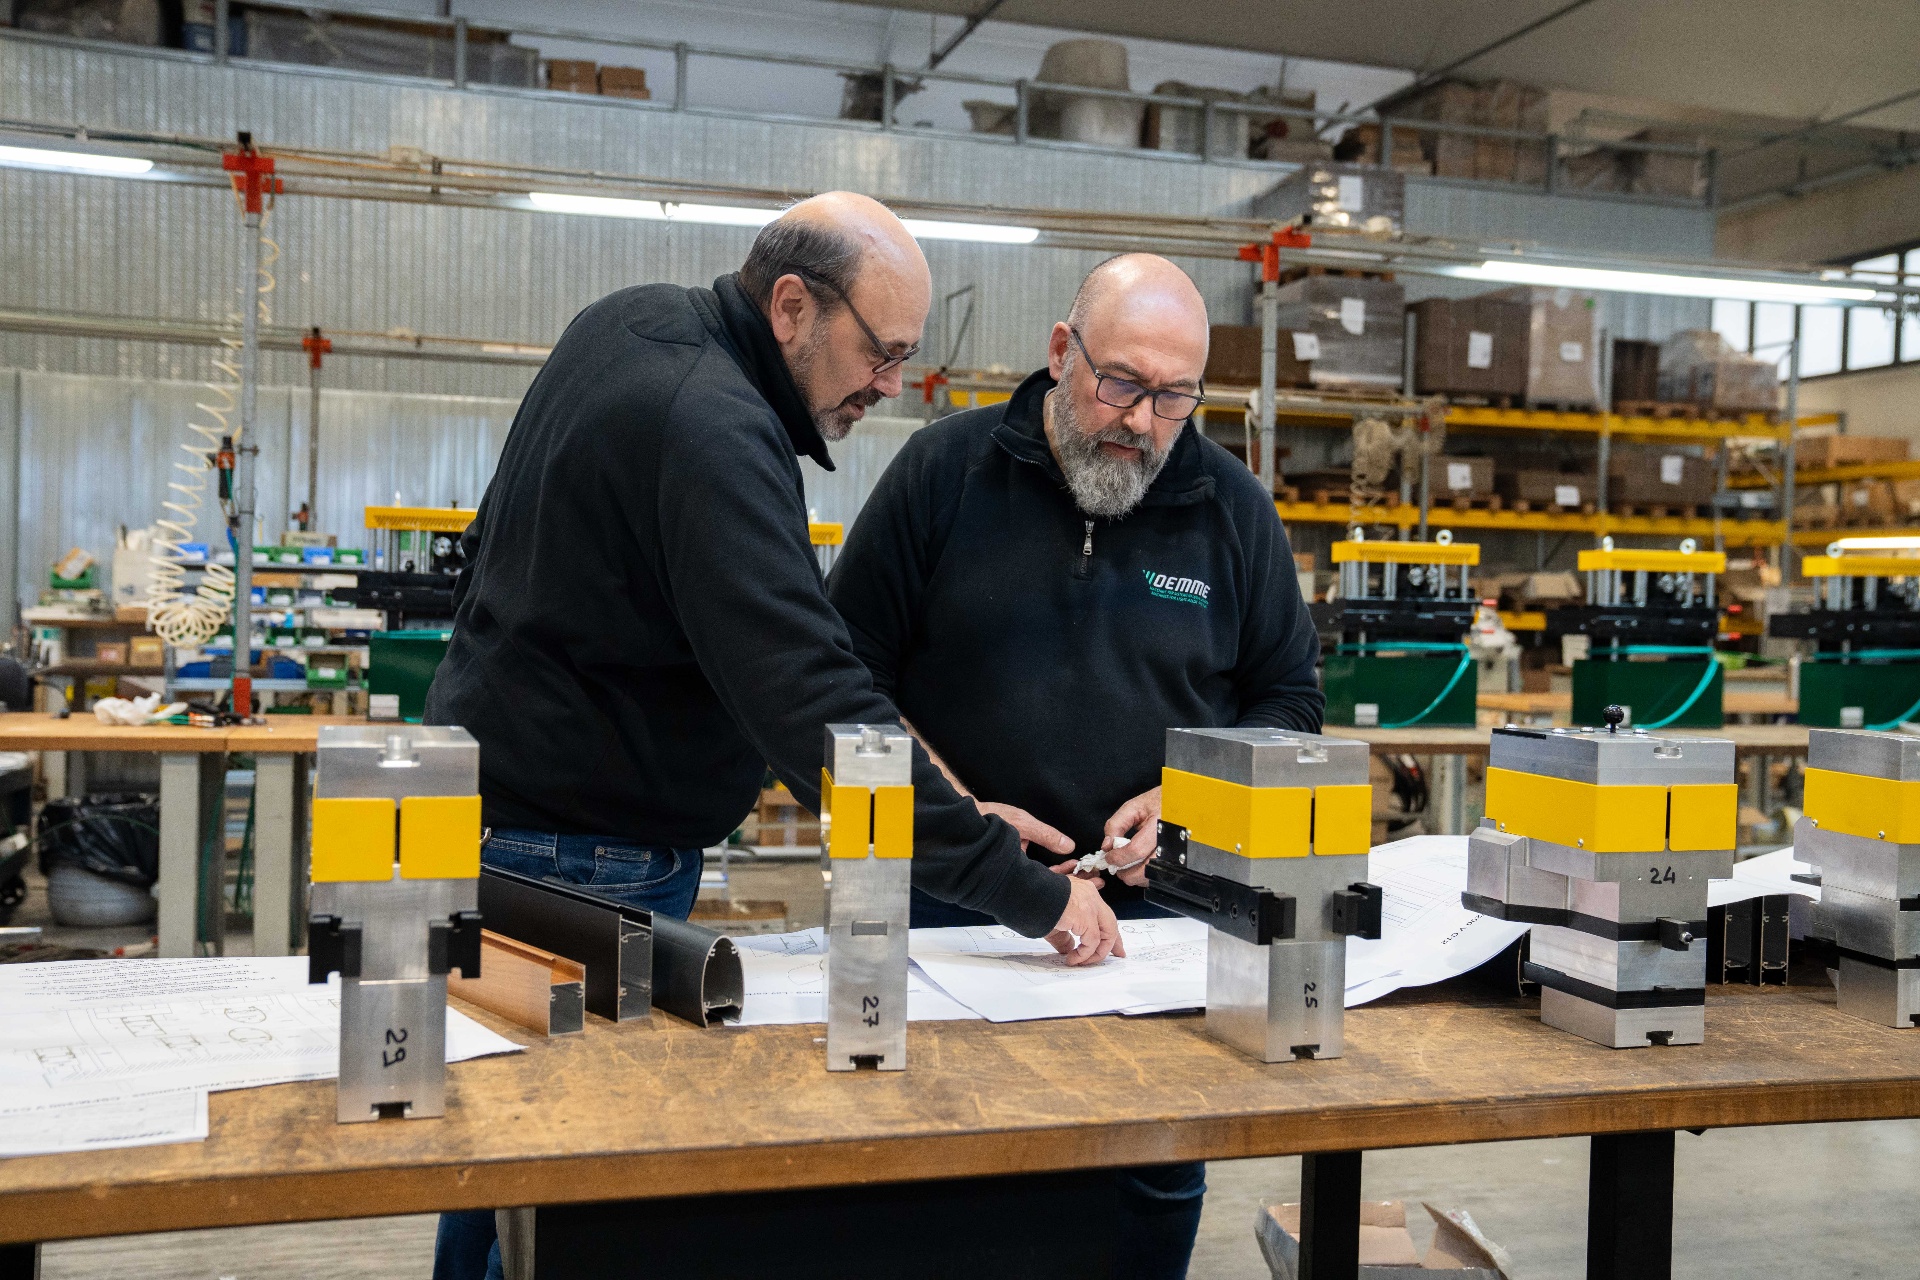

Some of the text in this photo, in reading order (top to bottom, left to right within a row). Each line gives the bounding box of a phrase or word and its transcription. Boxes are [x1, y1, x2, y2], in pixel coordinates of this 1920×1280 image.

[1153, 574, 1211, 599] OEMME
[1650, 866, 1676, 885] 24
[1304, 982, 1318, 1009] 25
[862, 996, 879, 1028] 27
[383, 1028, 408, 1068] 29
